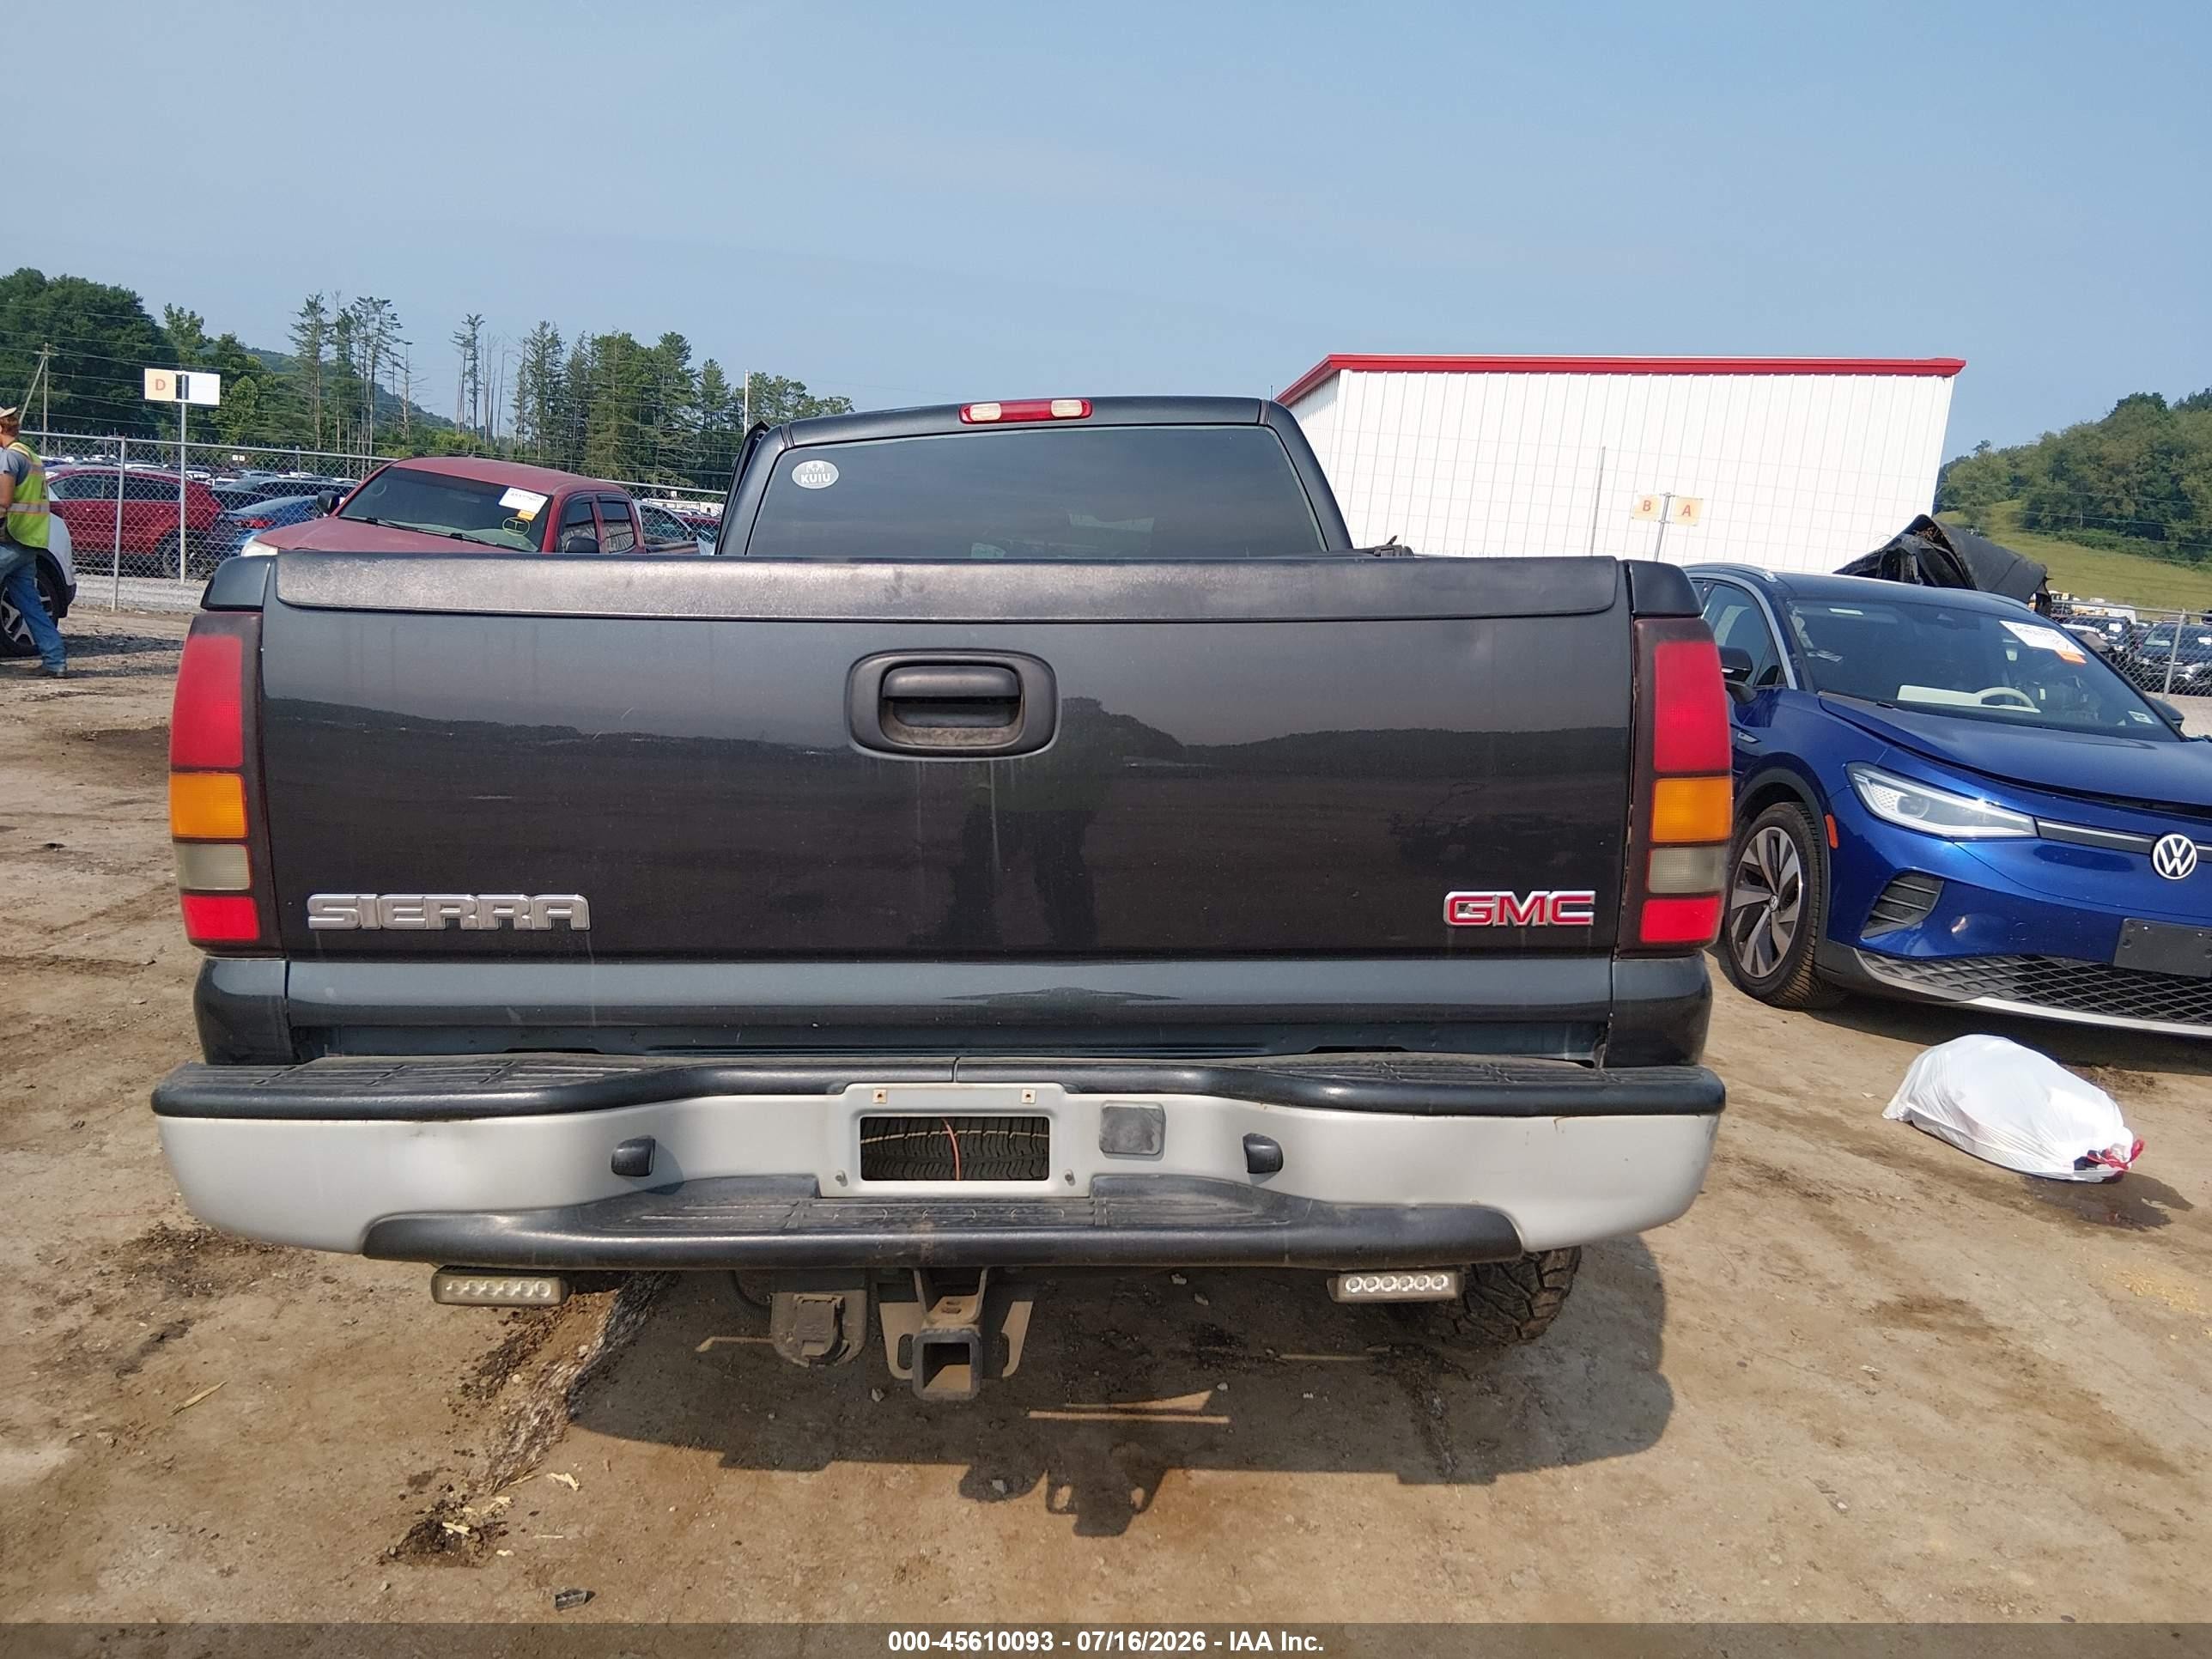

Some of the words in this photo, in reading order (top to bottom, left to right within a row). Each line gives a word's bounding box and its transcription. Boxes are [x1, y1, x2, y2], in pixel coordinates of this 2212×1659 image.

[155, 379, 166, 391] D
[800, 473, 830, 483] KUIU
[1643, 500, 1651, 512] B
[1681, 505, 1691, 517] A
[2154, 836, 2196, 878] VW
[307, 893, 591, 930] SIERRA
[1443, 890, 1596, 927] GMC
